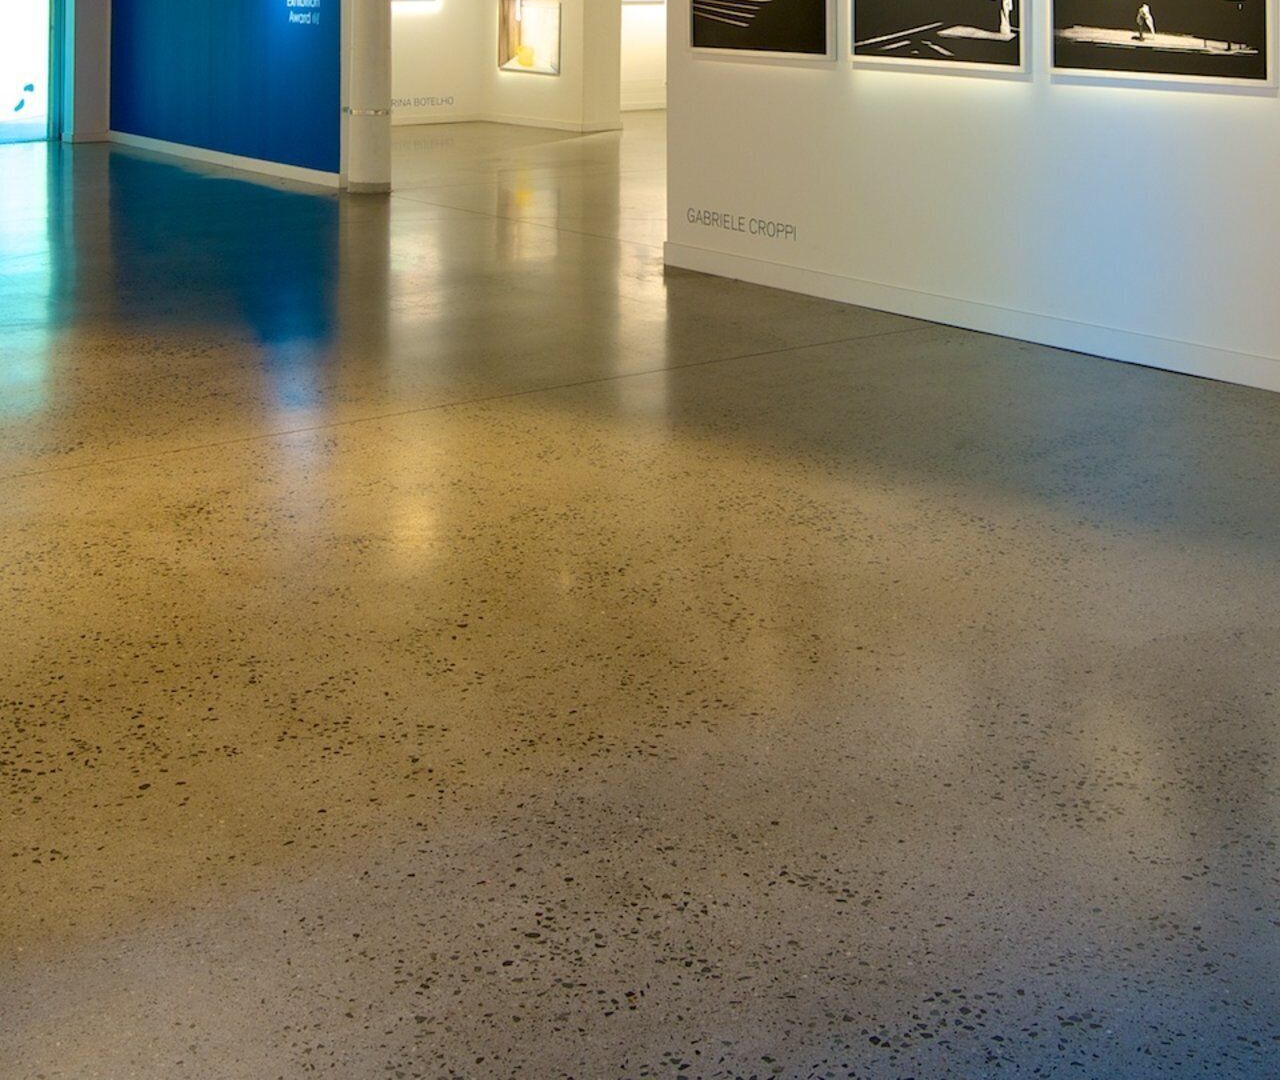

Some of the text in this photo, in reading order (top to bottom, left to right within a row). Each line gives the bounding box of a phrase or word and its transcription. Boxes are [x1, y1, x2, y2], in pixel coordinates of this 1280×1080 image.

[288, 11, 311, 24] Award
[413, 96, 454, 107] BOTELHO
[686, 207, 797, 241] GABRIELE CROPPI
